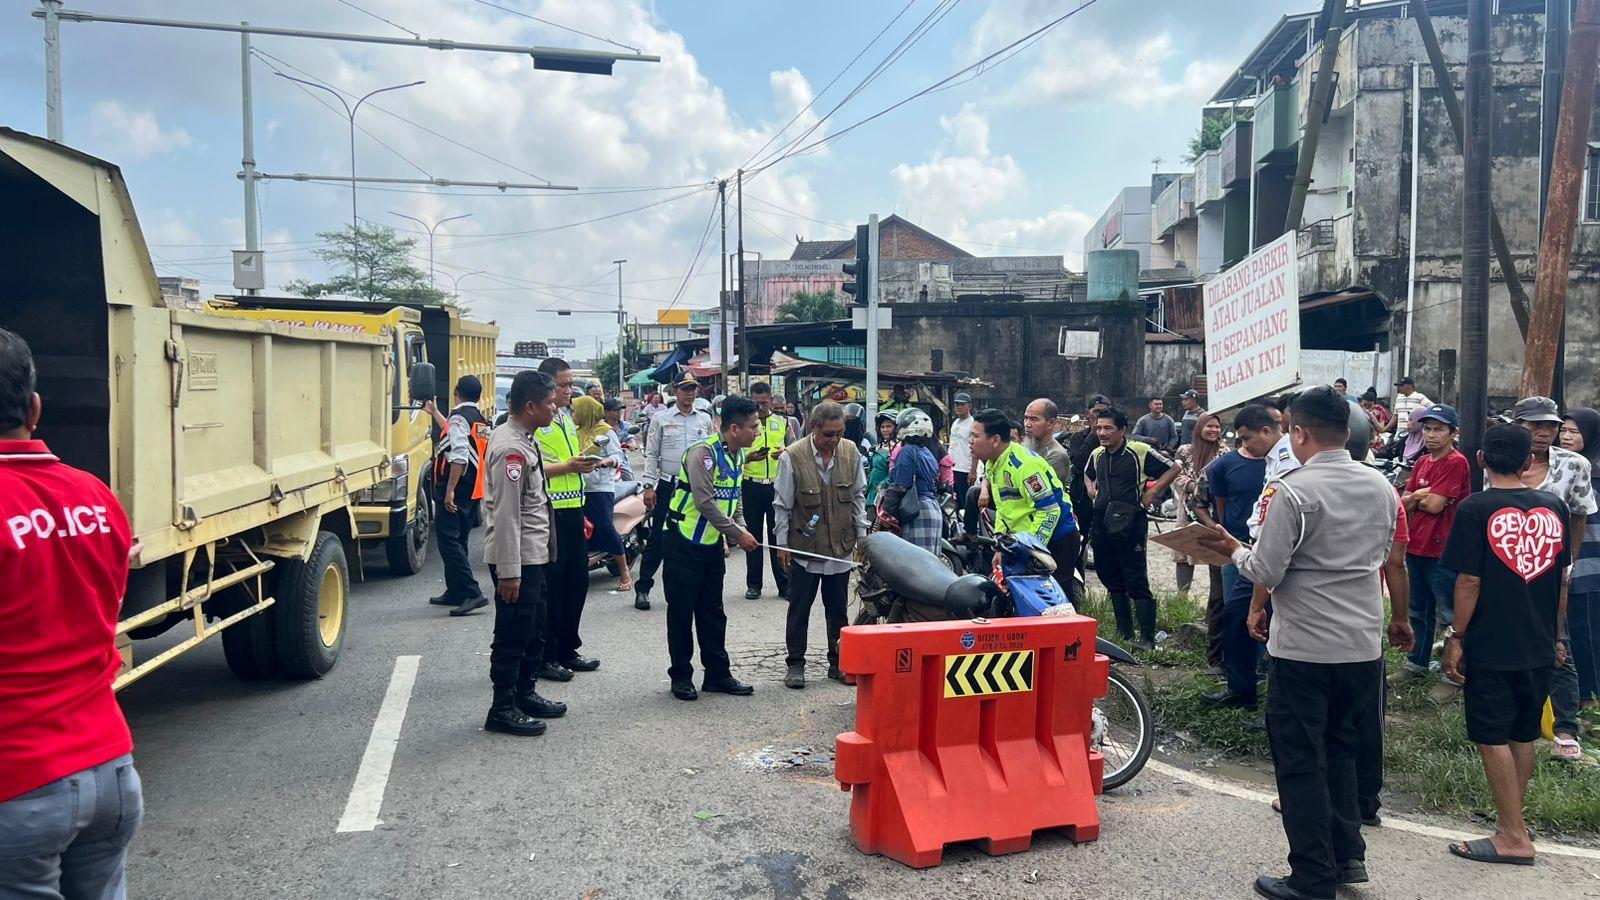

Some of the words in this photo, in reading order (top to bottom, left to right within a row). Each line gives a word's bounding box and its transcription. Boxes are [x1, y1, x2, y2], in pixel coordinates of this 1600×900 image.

[1208, 266, 1250, 307] DILARANG
[1252, 241, 1289, 282] PARKIR
[1212, 304, 1240, 332] ATAU
[1241, 273, 1285, 317] JUALAN
[1211, 340, 1222, 364] DI
[1224, 308, 1288, 357] SEPANJANG
[1214, 356, 1254, 392] JALAN
[1258, 342, 1286, 372] INI!
[1490, 511, 1562, 538] BEYOND
[1495, 533, 1562, 560] FANT
